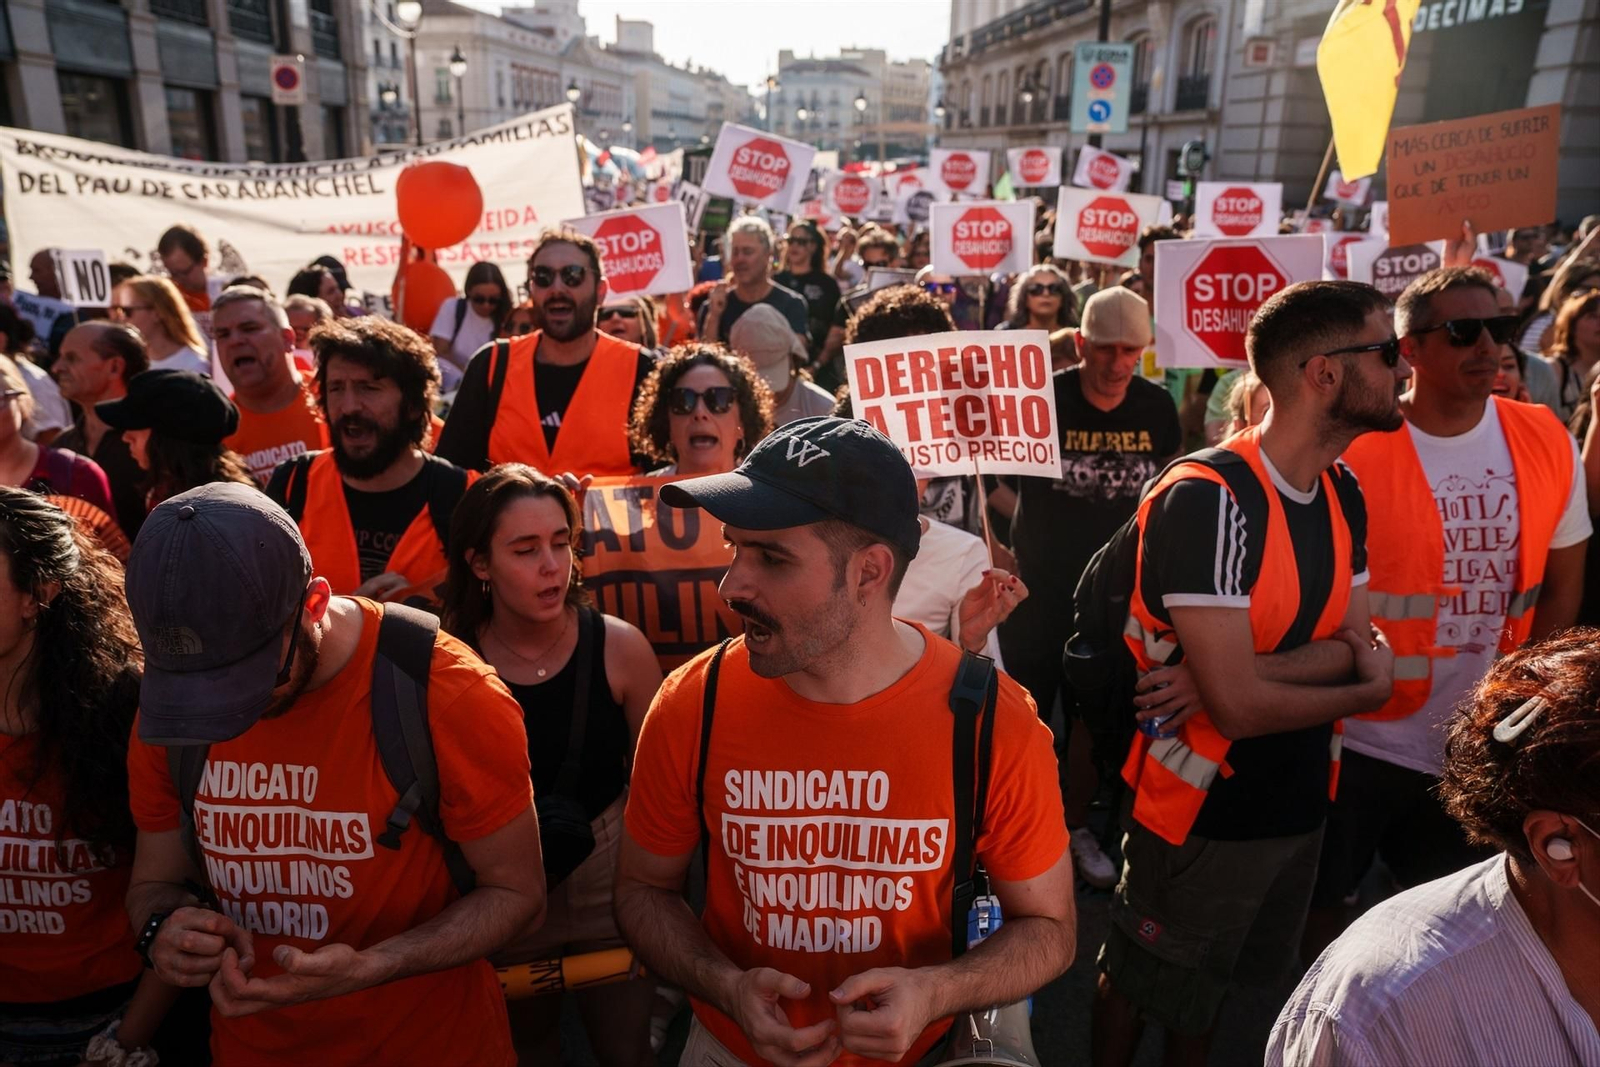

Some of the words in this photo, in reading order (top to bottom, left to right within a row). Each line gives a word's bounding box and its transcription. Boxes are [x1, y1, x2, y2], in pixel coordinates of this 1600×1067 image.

[1431, 128, 1476, 152] CERCA
[1478, 125, 1496, 144] DE
[1500, 115, 1549, 139] SUFRIR
[735, 147, 789, 172] STOP
[1413, 160, 1437, 176] UN
[18, 172, 68, 195] DEL
[74, 173, 131, 194] PAU
[141, 178, 173, 198] DE
[180, 173, 385, 200] CARABANCHEL
[1394, 182, 1423, 200] QUE
[1430, 177, 1447, 195] DE
[1457, 168, 1502, 188] TENER
[1507, 165, 1530, 182] UN
[1082, 208, 1136, 229] STOP
[1215, 197, 1261, 213] STOP
[596, 229, 655, 257] STOP
[956, 219, 1009, 239] STOP
[602, 252, 663, 278] ESAHUCIOS
[1376, 252, 1437, 276] STOP
[1193, 272, 1278, 302] STOP
[854, 344, 1047, 401] DERECHO
[896, 394, 1051, 443] TECHO
[901, 440, 961, 467] USTO
[968, 439, 1055, 466] PRECIO!
[1064, 429, 1153, 451] MAREA
[724, 769, 890, 812] SINDICATO
[213, 811, 368, 856] INQUILINAS
[726, 820, 760, 861] DE
[766, 821, 942, 866] INQUILINAS
[748, 871, 914, 912] INQUILINOS
[221, 898, 330, 941] MADRID
[767, 913, 883, 954] MADRID
